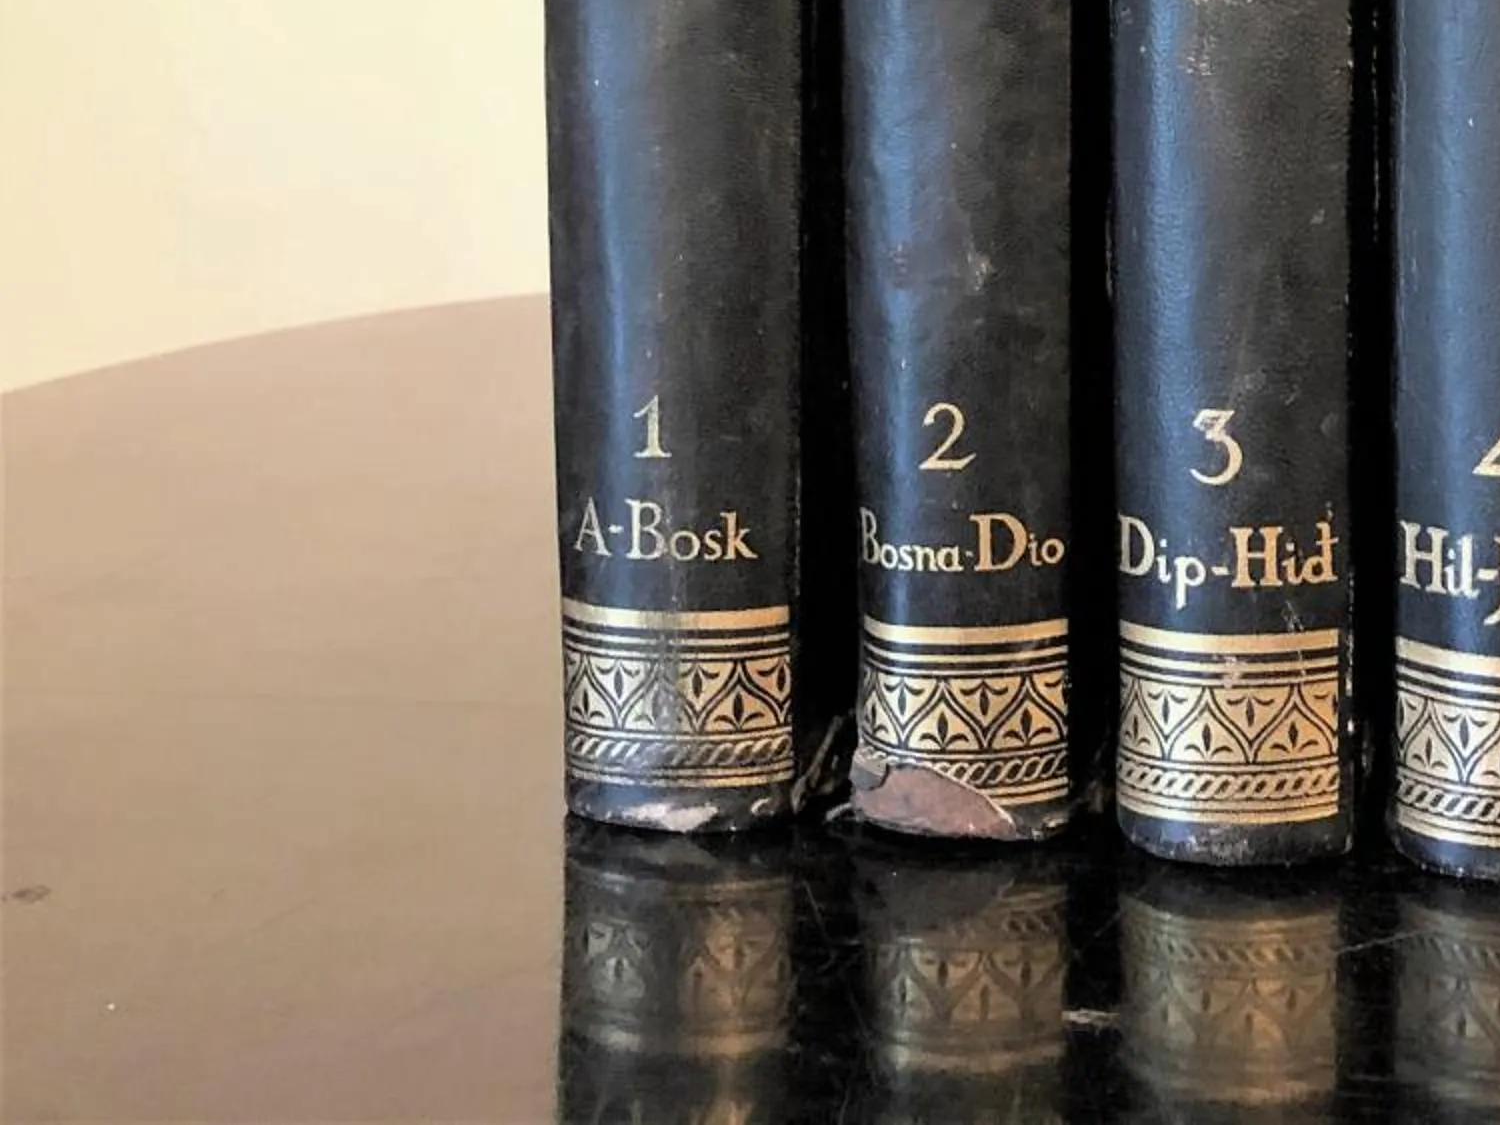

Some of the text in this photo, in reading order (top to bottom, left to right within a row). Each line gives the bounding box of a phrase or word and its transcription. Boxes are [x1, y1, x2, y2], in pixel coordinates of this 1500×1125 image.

[633, 394, 672, 459] 1
[918, 402, 976, 471] 2
[1190, 408, 1243, 486] 3
[573, 496, 758, 561] A-Bosk
[859, 506, 1064, 573] Bosna-Dio
